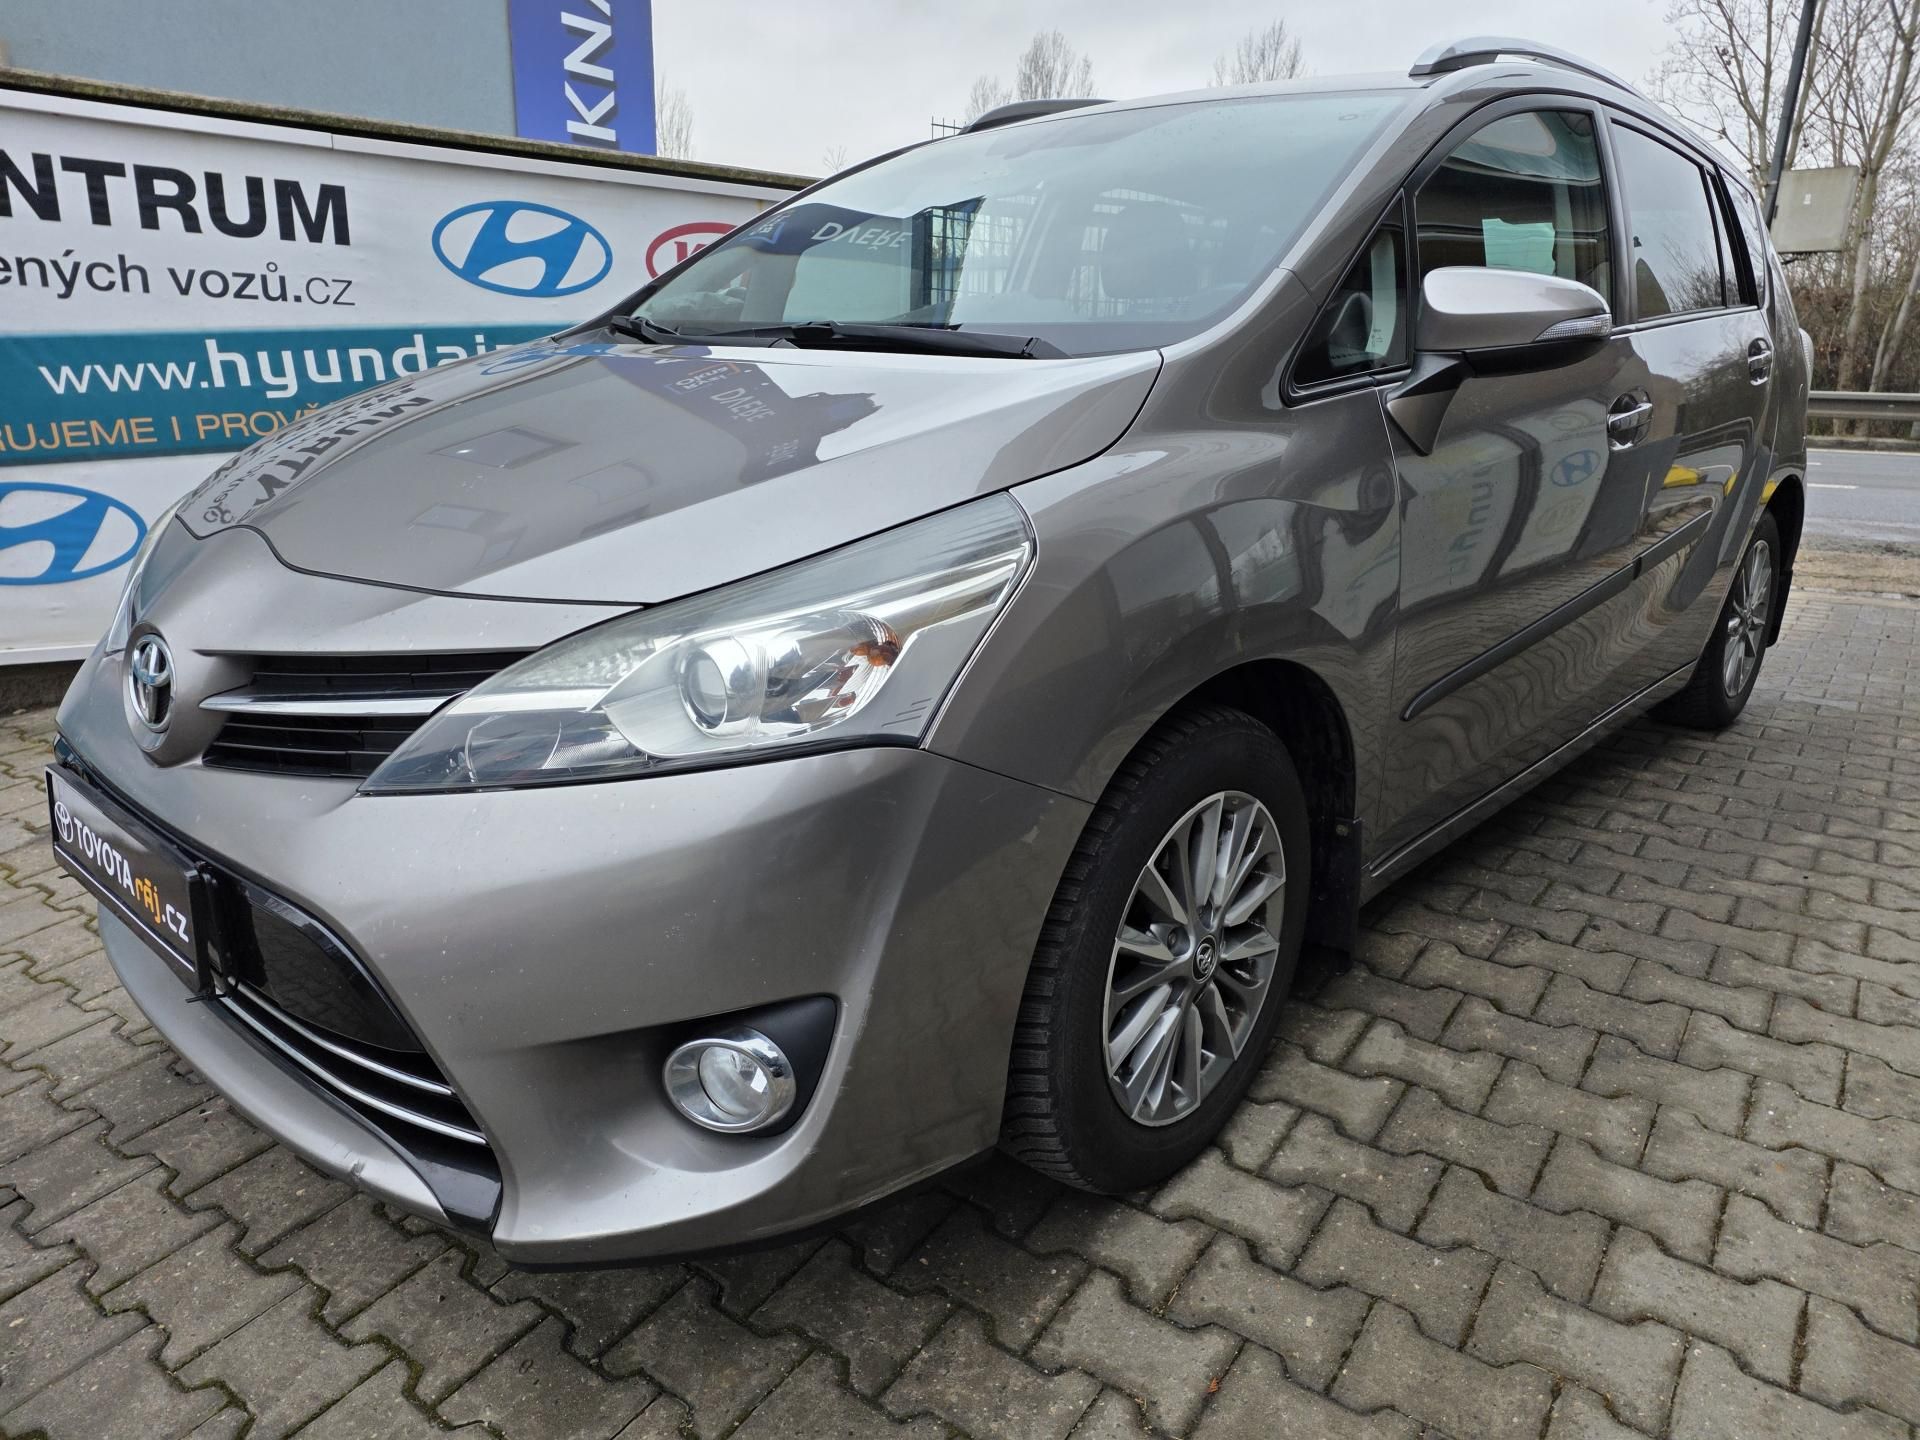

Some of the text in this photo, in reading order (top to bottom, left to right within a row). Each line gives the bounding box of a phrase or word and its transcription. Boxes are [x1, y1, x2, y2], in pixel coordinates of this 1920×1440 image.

[560, 0, 617, 141] KN
[0, 148, 351, 246] NTRUM
[38, 333, 512, 398] www.hyundai
[0, 417, 158, 451] UJEME
[171, 415, 182, 441] I
